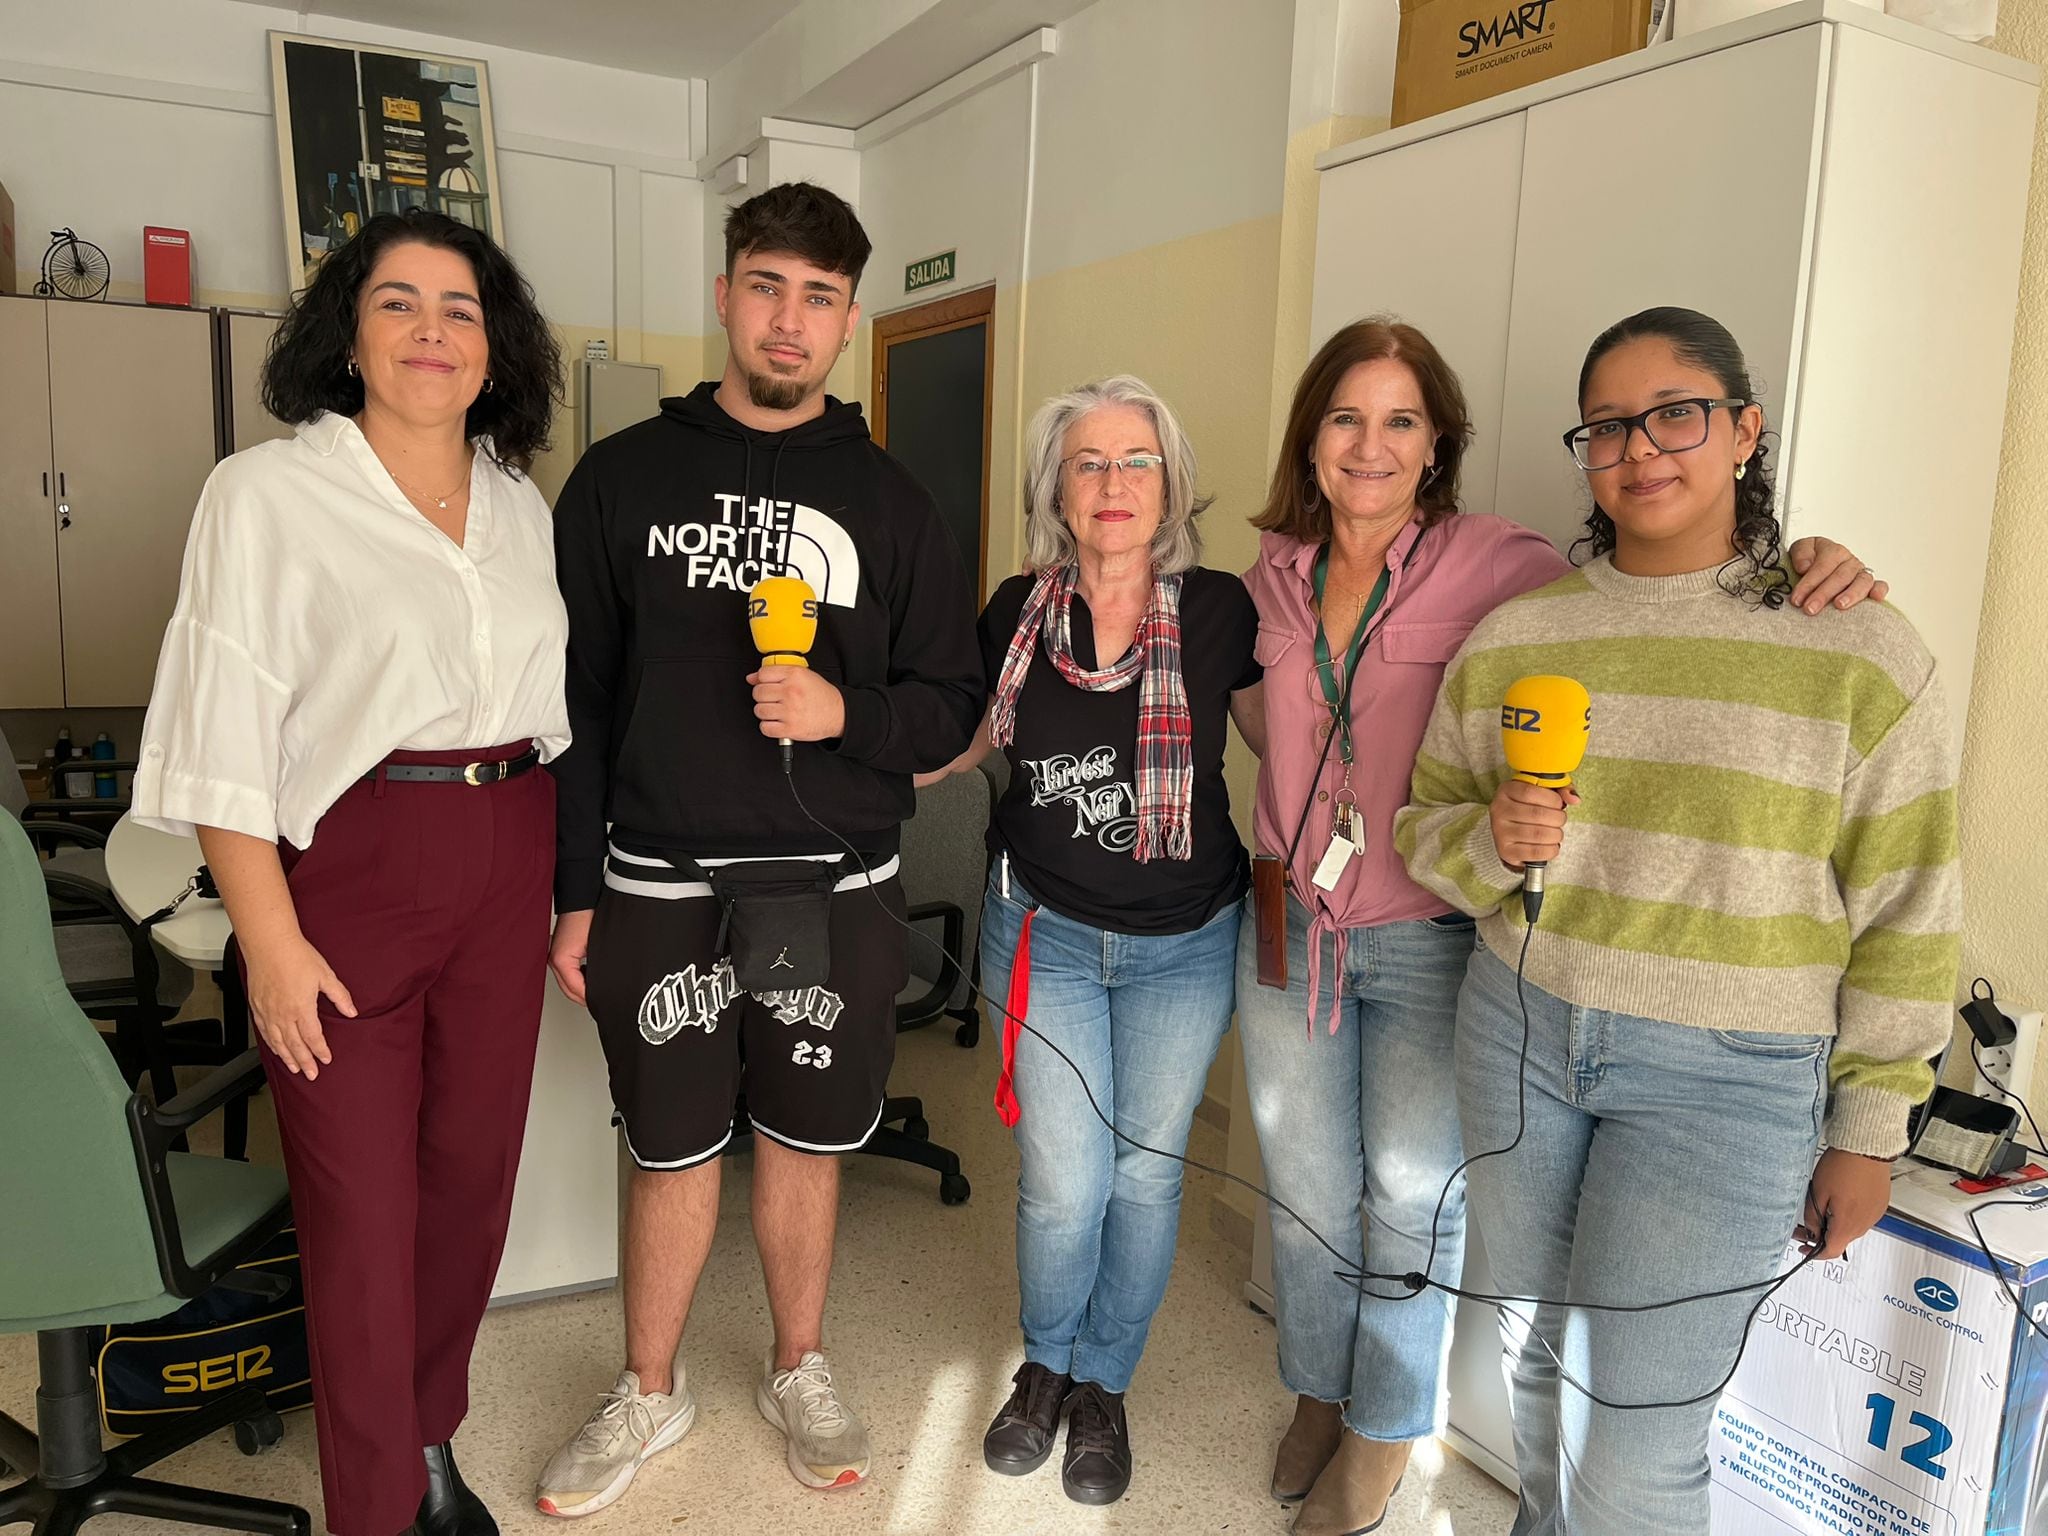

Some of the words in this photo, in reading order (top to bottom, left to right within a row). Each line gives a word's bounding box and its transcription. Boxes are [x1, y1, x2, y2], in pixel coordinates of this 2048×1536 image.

[1457, 0, 1555, 58] SMART
[1454, 64, 1479, 79] SMART
[1479, 52, 1520, 71] DOCUMENT
[1521, 41, 1553, 58] CAMERA
[909, 257, 950, 287] SALIDA
[714, 493, 792, 531] THE
[647, 523, 788, 564] NORTH
[1020, 745, 1117, 808] Harvest
[1063, 785, 1123, 839] Neil
[792, 1040, 833, 1070] 23
[1883, 1294, 1933, 1322] ACOUSTIC
[1936, 1316, 1984, 1343] CONTROL
[162, 1345, 273, 1393] SER
[1757, 1297, 1926, 1397] ORTABLE
[1720, 1455, 1727, 1466] 2
[1865, 1393, 1954, 1481] 12
[1717, 1409, 1764, 1441] EQUIPO
[1767, 1437, 1828, 1478] PORTÁTIL
[1831, 1473, 1908, 1520] COMPACTO
[1911, 1516, 1931, 1534] DE
[1721, 1427, 1742, 1444] 400
[1745, 1440, 1757, 1452] W
[1760, 1449, 1787, 1470] CON
[1790, 1465, 1887, 1526] REPRODUCTOR
[1820, 1498, 1863, 1528] RADIO
